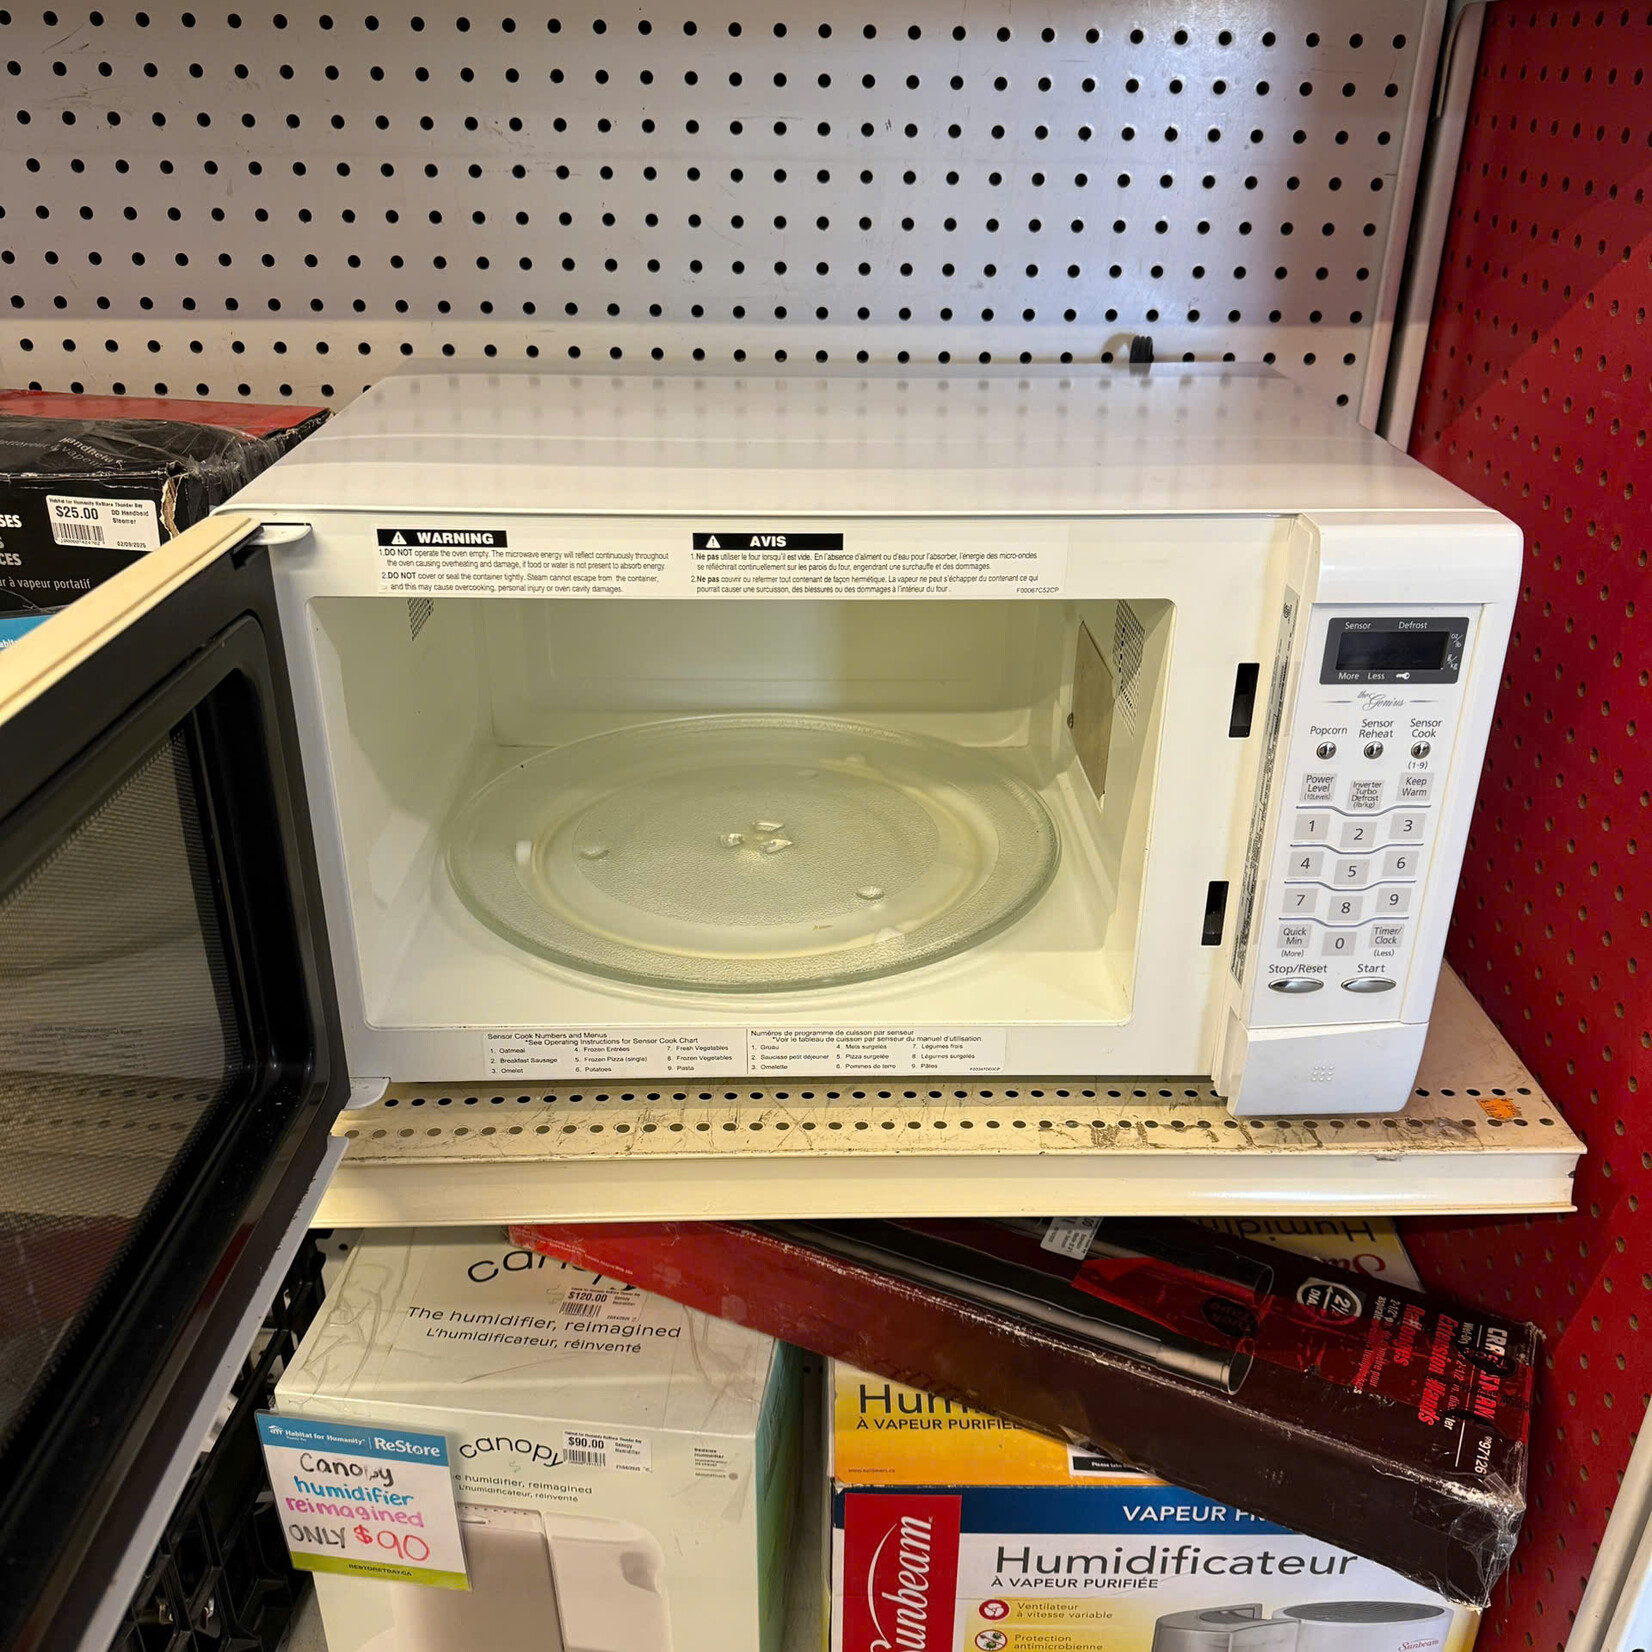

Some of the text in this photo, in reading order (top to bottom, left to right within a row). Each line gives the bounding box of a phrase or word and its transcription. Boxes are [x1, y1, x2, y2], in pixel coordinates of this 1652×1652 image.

[56, 506, 98, 520] $25.00
[417, 532, 494, 544] WARNING
[750, 536, 786, 547] AVIS
[596, 552, 633, 560] continuously
[635, 552, 668, 561] throughout
[17, 579, 50, 590] vapeur
[54, 578, 91, 591] portatif
[1362, 694, 1404, 711] Genius
[1362, 719, 1394, 728] Sensor
[1410, 718, 1442, 727] Sensor
[1310, 726, 1347, 736] Popcorn
[1359, 729, 1393, 738] Reheat
[1412, 729, 1436, 738] Cook
[1408, 761, 1428, 769] (1-9)
[1306, 775, 1334, 783] Power
[1406, 778, 1427, 787] Keep
[1308, 784, 1330, 792] Level
[1402, 788, 1427, 796] Warm
[1308, 820, 1314, 832] 1
[1403, 820, 1413, 832] 3
[1354, 829, 1363, 840] 2
[1300, 858, 1310, 869] 4
[1397, 857, 1406, 869] 6
[1348, 866, 1357, 877] 5
[1297, 895, 1305, 906] 7
[1390, 894, 1399, 905] 9
[1341, 902, 1351, 913] 8
[1283, 928, 1306, 937] Quick
[1335, 938, 1344, 949] 0
[1269, 964, 1385, 974] Stop/Reset Start
[568, 1291, 608, 1302] $120.00
[408, 1306, 682, 1338] The humidifier, reimagined
[426, 1327, 641, 1353] L'humidificateur, réinventé
[1428, 1313, 1458, 1375] Extension
[1418, 1379, 1447, 1425] Wands
[856, 1416, 868, 1429] À
[873, 1419, 942, 1430] VAPEUR
[285, 1430, 312, 1439] Habitat
[327, 1435, 363, 1445] Humanity
[568, 1436, 604, 1449] $90.00
[374, 1437, 441, 1457] ReStore
[459, 1436, 564, 1468] canopy
[465, 1475, 525, 1488] humidifier,
[529, 1481, 592, 1494] reimagined
[293, 1476, 414, 1506] humidifier
[535, 1492, 579, 1502] réinventé
[285, 1496, 424, 1528] reimagined
[1123, 1505, 1227, 1522] VAPEUR
[288, 1524, 430, 1562] ONLY $90
[996, 1545, 1358, 1575] Humidificateur
[991, 1576, 1159, 1589] À VAPEUR PURIFIÉE
[1017, 1602, 1078, 1611] Ventilateur
[1017, 1610, 1022, 1619] à
[1069, 1611, 1112, 1619] variable
[1014, 1634, 1071, 1643] Protection
[1014, 1643, 1103, 1651] antimicrobienne
[1398, 1640, 1439, 1652] Sunbeam
